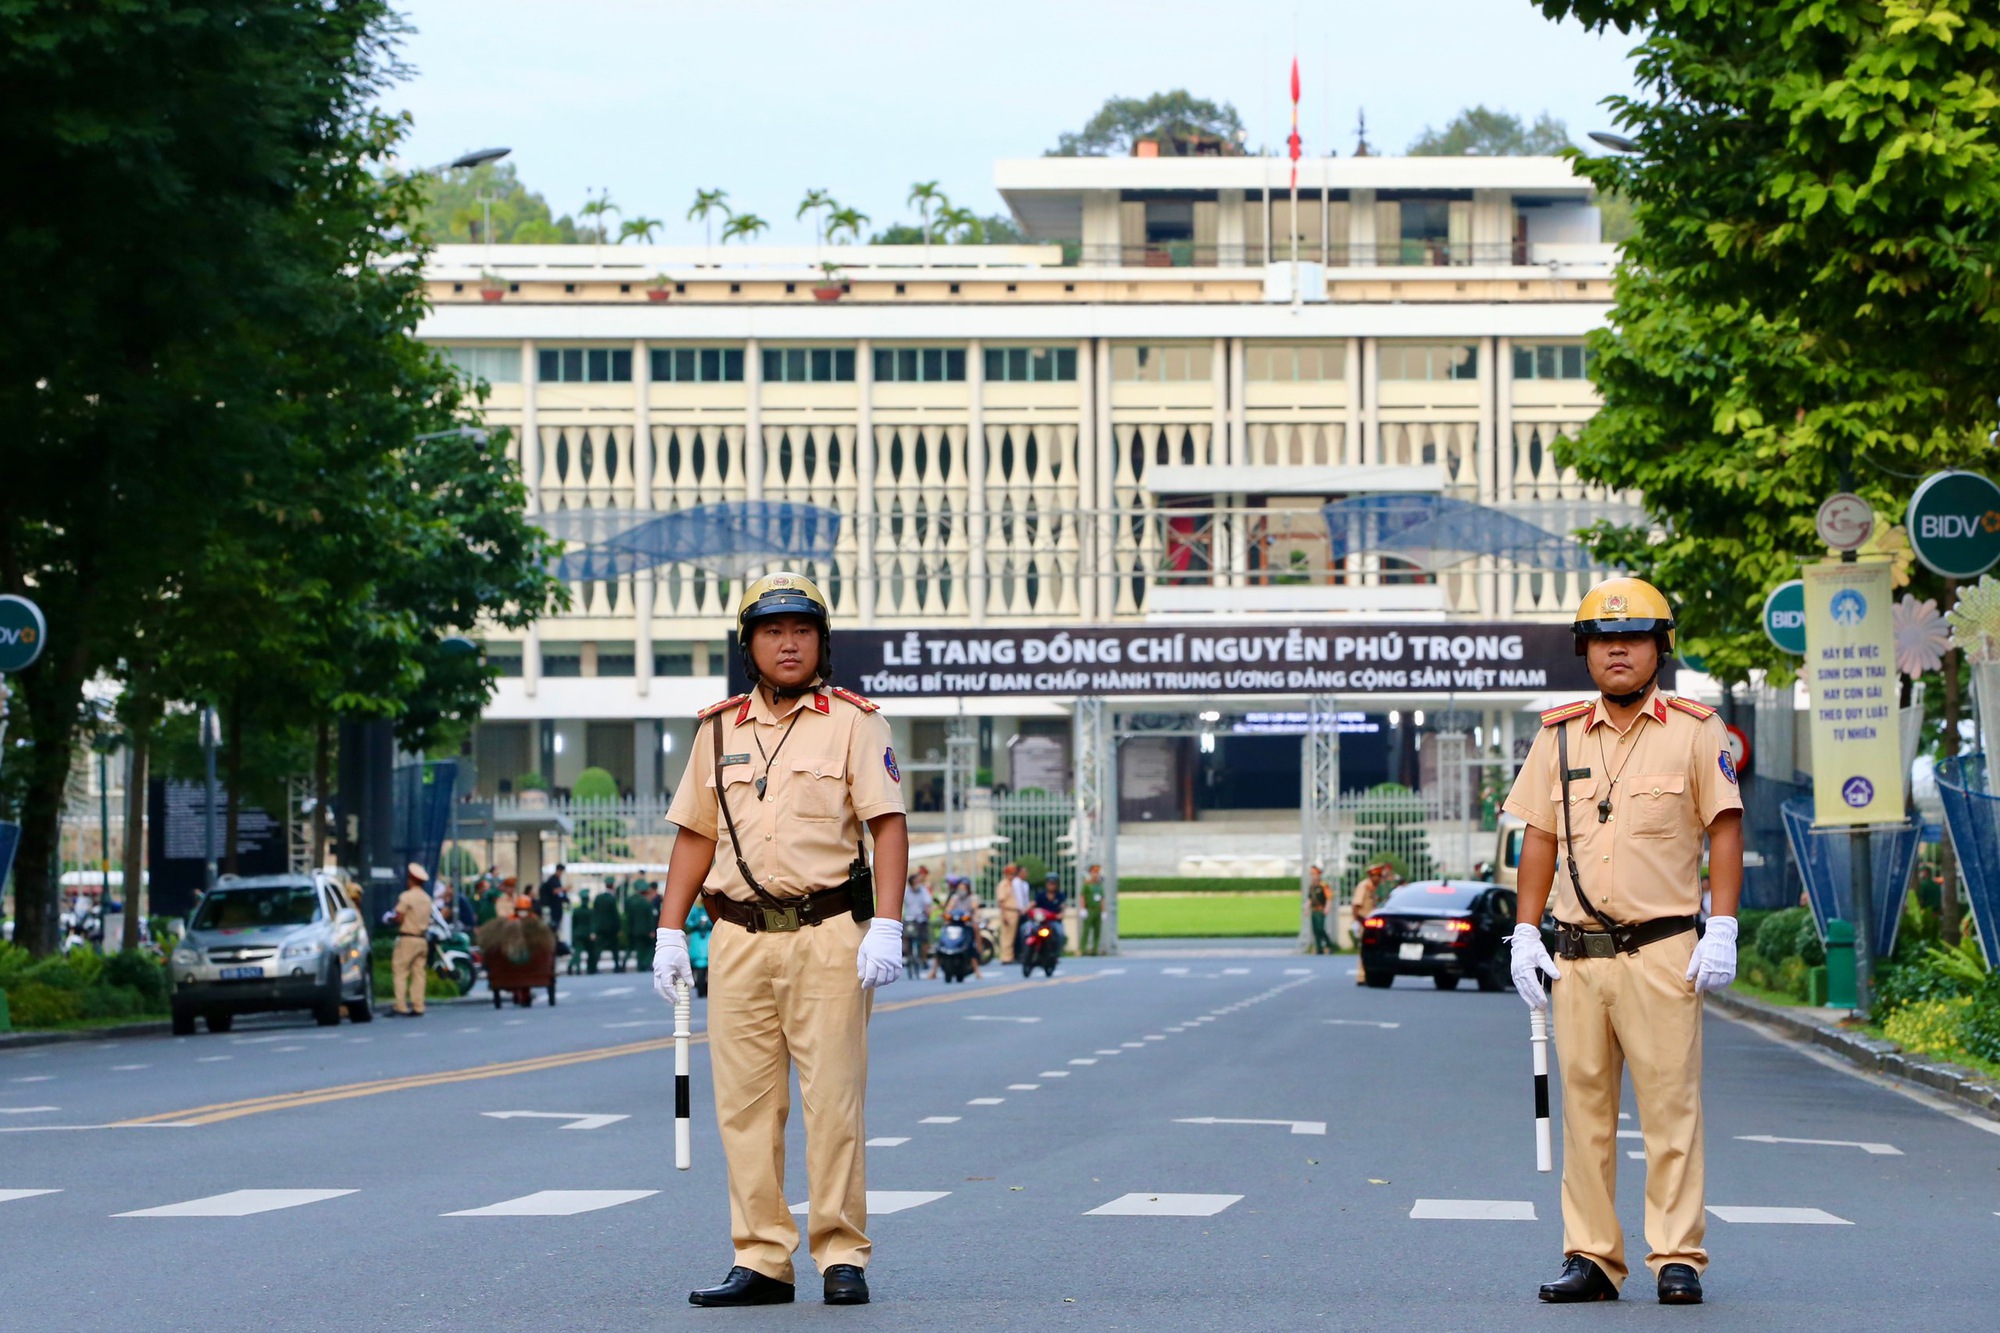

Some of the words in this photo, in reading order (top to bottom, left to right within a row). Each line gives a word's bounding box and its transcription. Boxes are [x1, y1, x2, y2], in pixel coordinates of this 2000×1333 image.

[1921, 514, 1981, 538] BIDV
[883, 632, 921, 665] LỄ
[925, 639, 1016, 665] TANG
[1021, 631, 1121, 664] ĐỒNG
[1127, 633, 1186, 663] CHÍ
[1190, 628, 1327, 662] NGUYỄN
[1335, 631, 1404, 661] PHÚ
[1408, 635, 1523, 668] TRỌNG
[860, 669, 918, 693] TỔNG
[920, 671, 942, 692] BÍ
[944, 671, 988, 692] THƯ
[989, 674, 1033, 692] BAN
[1034, 668, 1091, 691] CHẤP
[1092, 670, 1150, 690] HÀNH
[1151, 672, 1221, 690] TRUNG
[1223, 670, 1286, 689] ƯƠNG
[1287, 666, 1347, 688] ĐẢNG
[1349, 669, 1408, 691] CỘNG
[1410, 665, 1451, 687] SẢN
[1452, 666, 1498, 691] VIỆT
[1499, 669, 1547, 687] NAM
